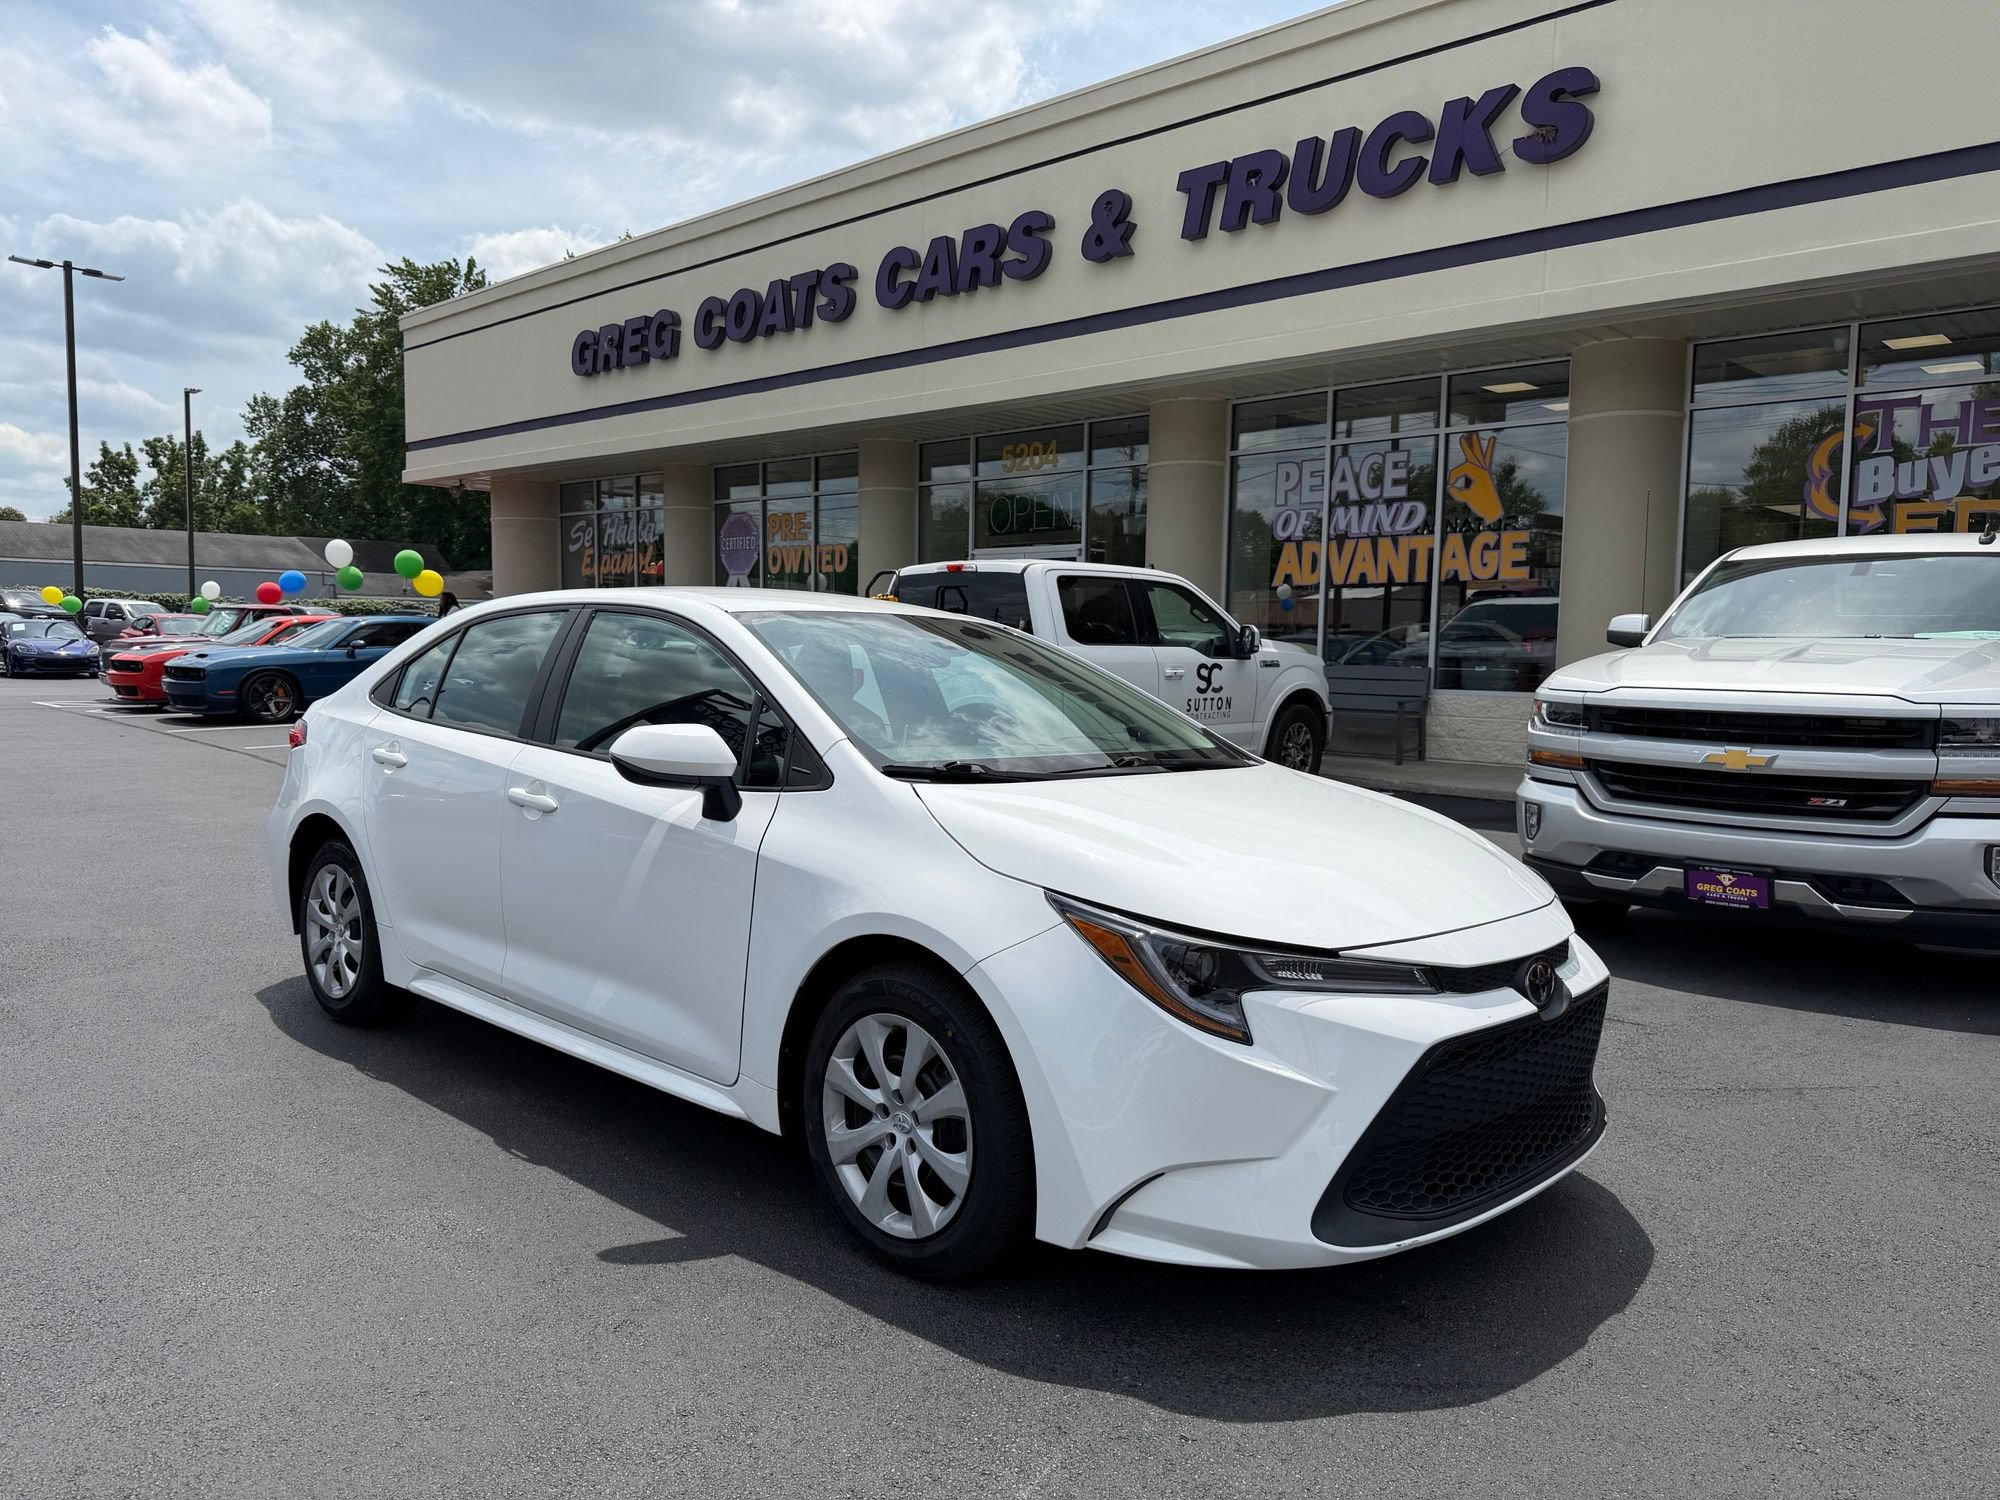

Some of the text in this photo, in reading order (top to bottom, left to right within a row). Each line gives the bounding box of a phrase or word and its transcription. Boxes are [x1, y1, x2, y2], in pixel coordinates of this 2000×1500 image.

[572, 66, 1600, 377] GREG COATS CARS & TRUCKS
[1855, 394, 2000, 453] THE
[1002, 440, 1058, 474] 5204
[1275, 450, 1411, 507] PEACE
[990, 491, 1073, 534] OPEN
[1273, 509, 1321, 541] OF
[1329, 501, 1427, 538] MIND
[569, 520, 593, 552] Se
[721, 536, 756, 551] CERTIFIED
[582, 544, 654, 584] Epañl
[767, 543, 848, 575] OWNED
[1271, 529, 1530, 587] ADVANTAGE
[1186, 696, 1232, 712] SUTTON
[1696, 883, 1758, 897] GREG COATS
